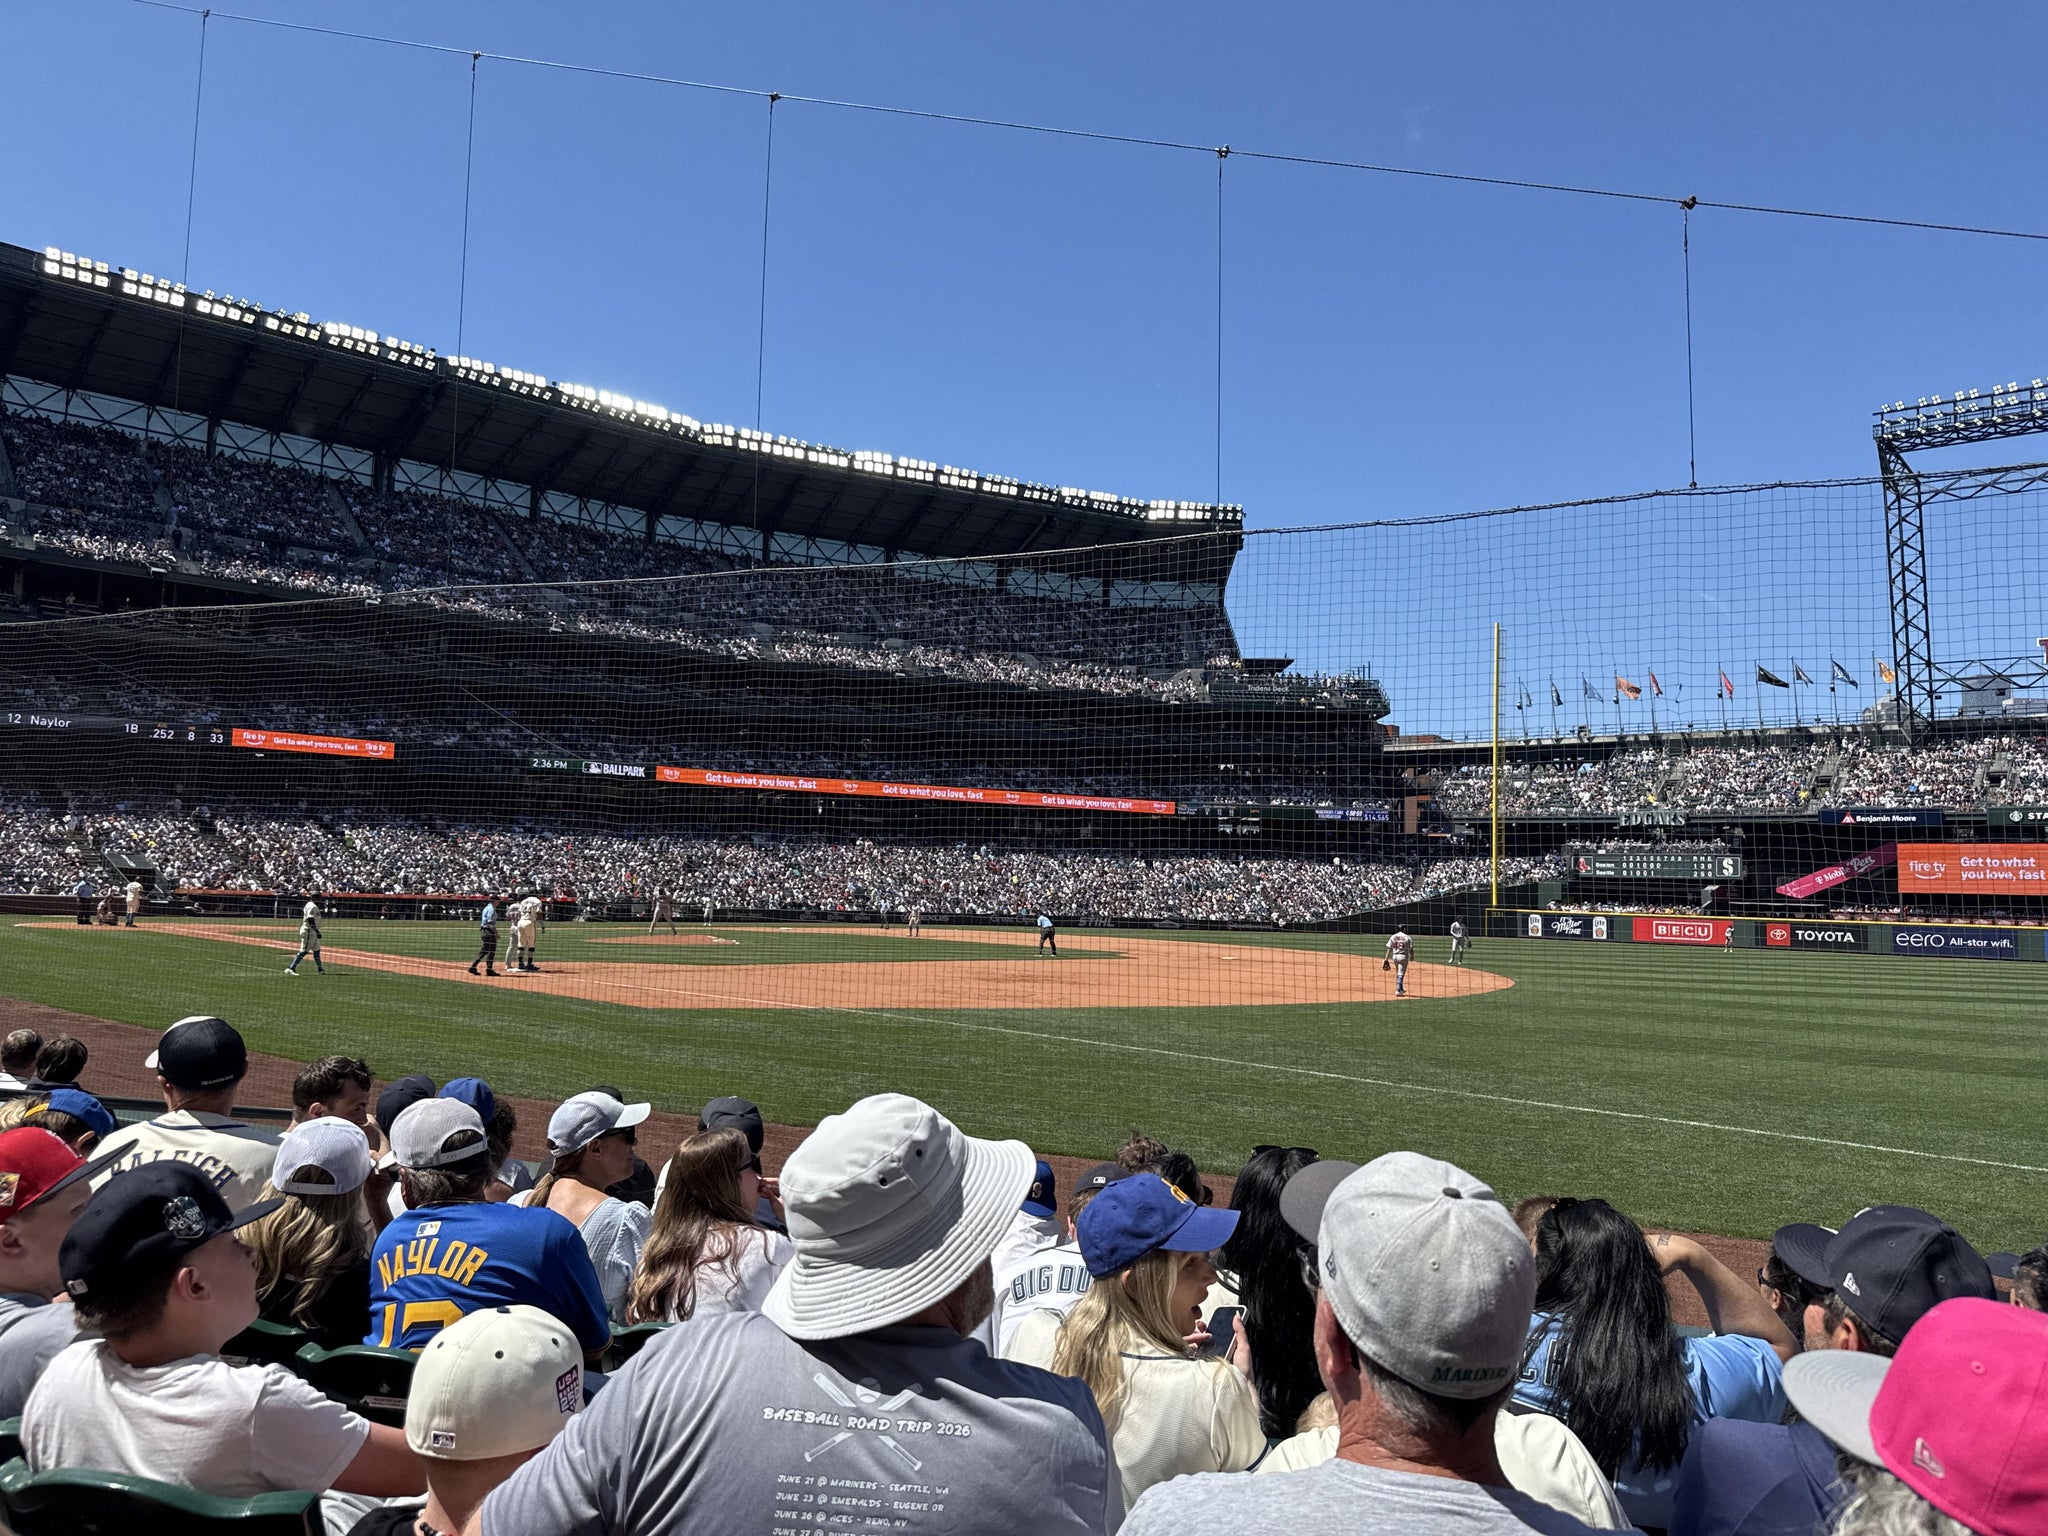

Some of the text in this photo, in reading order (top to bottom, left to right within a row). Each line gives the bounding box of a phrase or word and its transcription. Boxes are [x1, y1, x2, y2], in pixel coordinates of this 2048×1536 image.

[8, 713, 71, 728] 12 Naylor
[125, 724, 223, 743] 1B .252 8 33
[533, 759, 567, 769] 2:36 PM
[603, 763, 645, 777] BALLPARK
[706, 773, 816, 789] Get to what you love, fast
[883, 785, 983, 799] Get to what you love, fast
[1041, 796, 1133, 810] Get to what you love, fast
[1856, 815, 1890, 824] Benjamin
[1909, 861, 1946, 872] fire tv
[1961, 857, 2035, 867] Get to what
[1961, 869, 2047, 881] you love, fast
[1078, 917, 1114, 928] STIHL
[1551, 919, 1582, 934] Miller
[1658, 925, 1708, 936] BECU
[1796, 930, 1854, 943] TOYOTA
[1896, 933, 2013, 948] eero All-star wifi.
[377, 1238, 488, 1292] NAYLOR
[1011, 1265, 1053, 1304] BIG
[558, 1370, 577, 1390] USA
[762, 1406, 971, 1437] BASEBALL ROAD TRIP 2026
[777, 1474, 801, 1483] JUNE
[805, 1477, 814, 1485] 21
[818, 1476, 828, 1487] @
[830, 1479, 878, 1490] MARINERS
[889, 1483, 930, 1495] SEATTLE,
[935, 1486, 949, 1495] WA
[776, 1492, 799, 1501] JUNE
[803, 1494, 814, 1502] 23
[818, 1493, 828, 1504] @
[831, 1496, 882, 1508] EMERALDS
[893, 1501, 929, 1511] EUGENE
[932, 1504, 944, 1512] OR
[774, 1510, 798, 1519] JUNE
[801, 1512, 812, 1520] 26
[816, 1511, 827, 1522] @
[830, 1514, 854, 1523] ACES
[865, 1517, 891, 1527] RENO,
[894, 1519, 908, 1527] NV
[773, 1528, 796, 1536] JUNE
